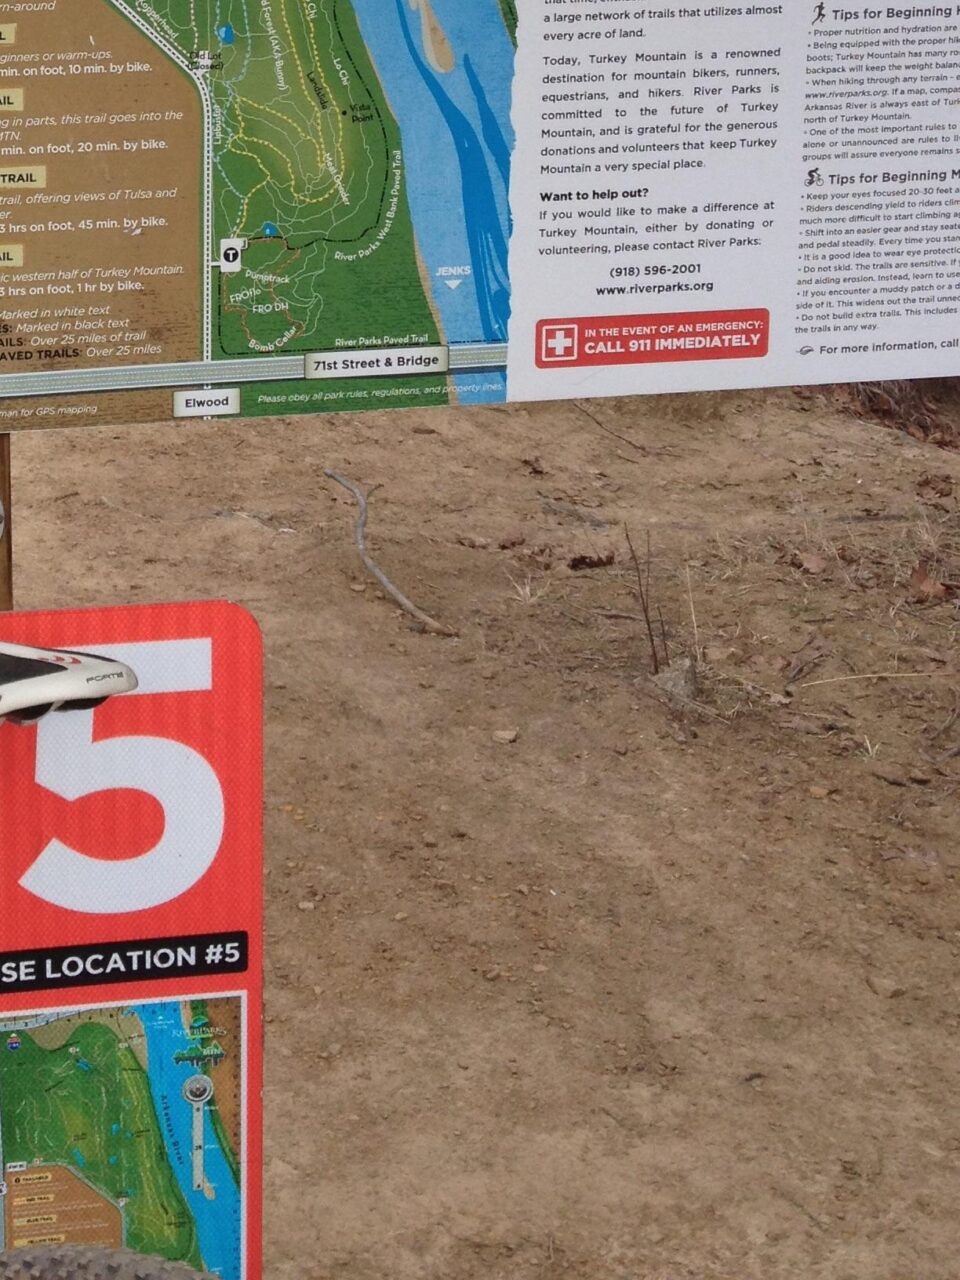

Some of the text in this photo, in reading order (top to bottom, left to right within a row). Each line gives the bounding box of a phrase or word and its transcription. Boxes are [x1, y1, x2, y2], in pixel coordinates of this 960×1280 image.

[832, 5, 953, 22] Tips for Beginning
[22, 67, 38, 77] on
[39, 64, 67, 76] foot,
[68, 64, 82, 75] 10
[83, 63, 108, 74] min.
[109, 62, 125, 75] by
[126, 61, 153, 72] bike.
[0, 172, 37, 184] TRAIL
[828, 169, 947, 187] Tips for Beginning
[539, 187, 649, 202] Want to help out?
[435, 265, 471, 276] JENKS
[609, 263, 701, 279] (918) 596-2001
[595, 281, 714, 296] www.riverparks.org
[252, 302, 289, 313] FRO DH
[584, 320, 764, 338] IN THE EVENT OF AN EMERGENCY:
[248, 338, 275, 351] Bomb
[334, 333, 429, 347] River Parks Paved Trail
[584, 333, 761, 354] CALL 911 IMMEDIATELY
[819, 338, 960, 355] For more information, call
[313, 355, 440, 371] 71st Street & Bridge
[185, 396, 229, 408] Elwood
[17, 636, 226, 915] 5
[45, 945, 196, 979] LOCATION
[204, 942, 240, 965] #5
